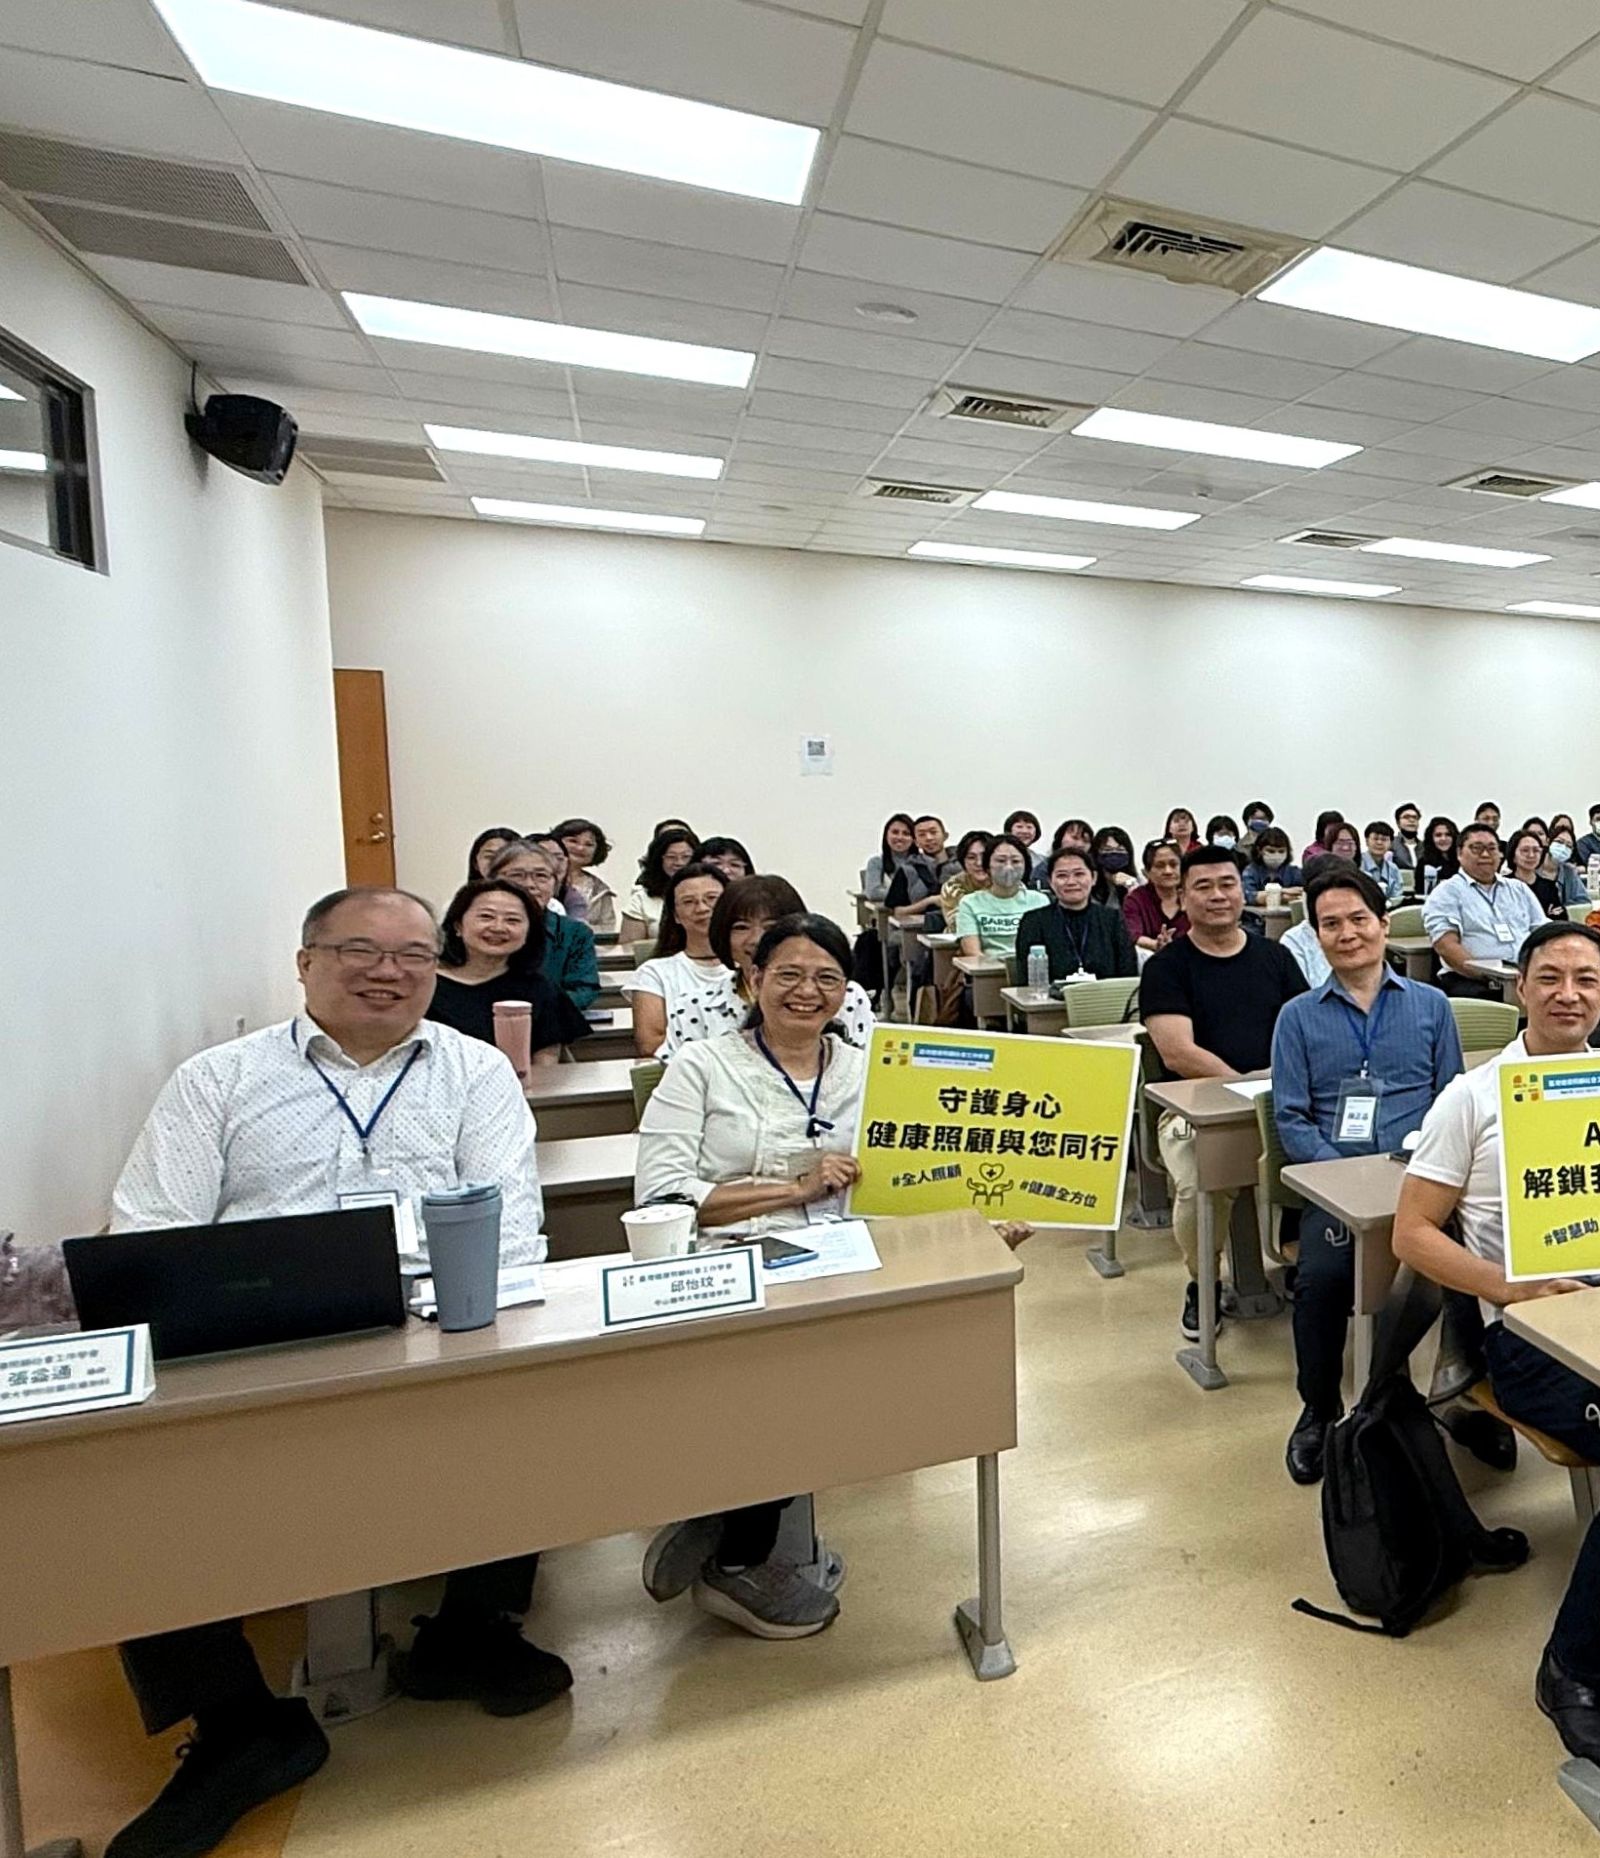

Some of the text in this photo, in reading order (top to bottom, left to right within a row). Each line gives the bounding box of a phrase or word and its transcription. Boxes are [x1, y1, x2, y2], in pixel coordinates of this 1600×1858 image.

[938, 1086, 1062, 1120] 守護身心
[867, 1120, 1119, 1161] 健康照顧與您同行
[892, 1163, 962, 1188] #全人照顧
[1019, 1180, 1099, 1208] #健康全方位
[671, 1276, 714, 1293] 邱怡玟
